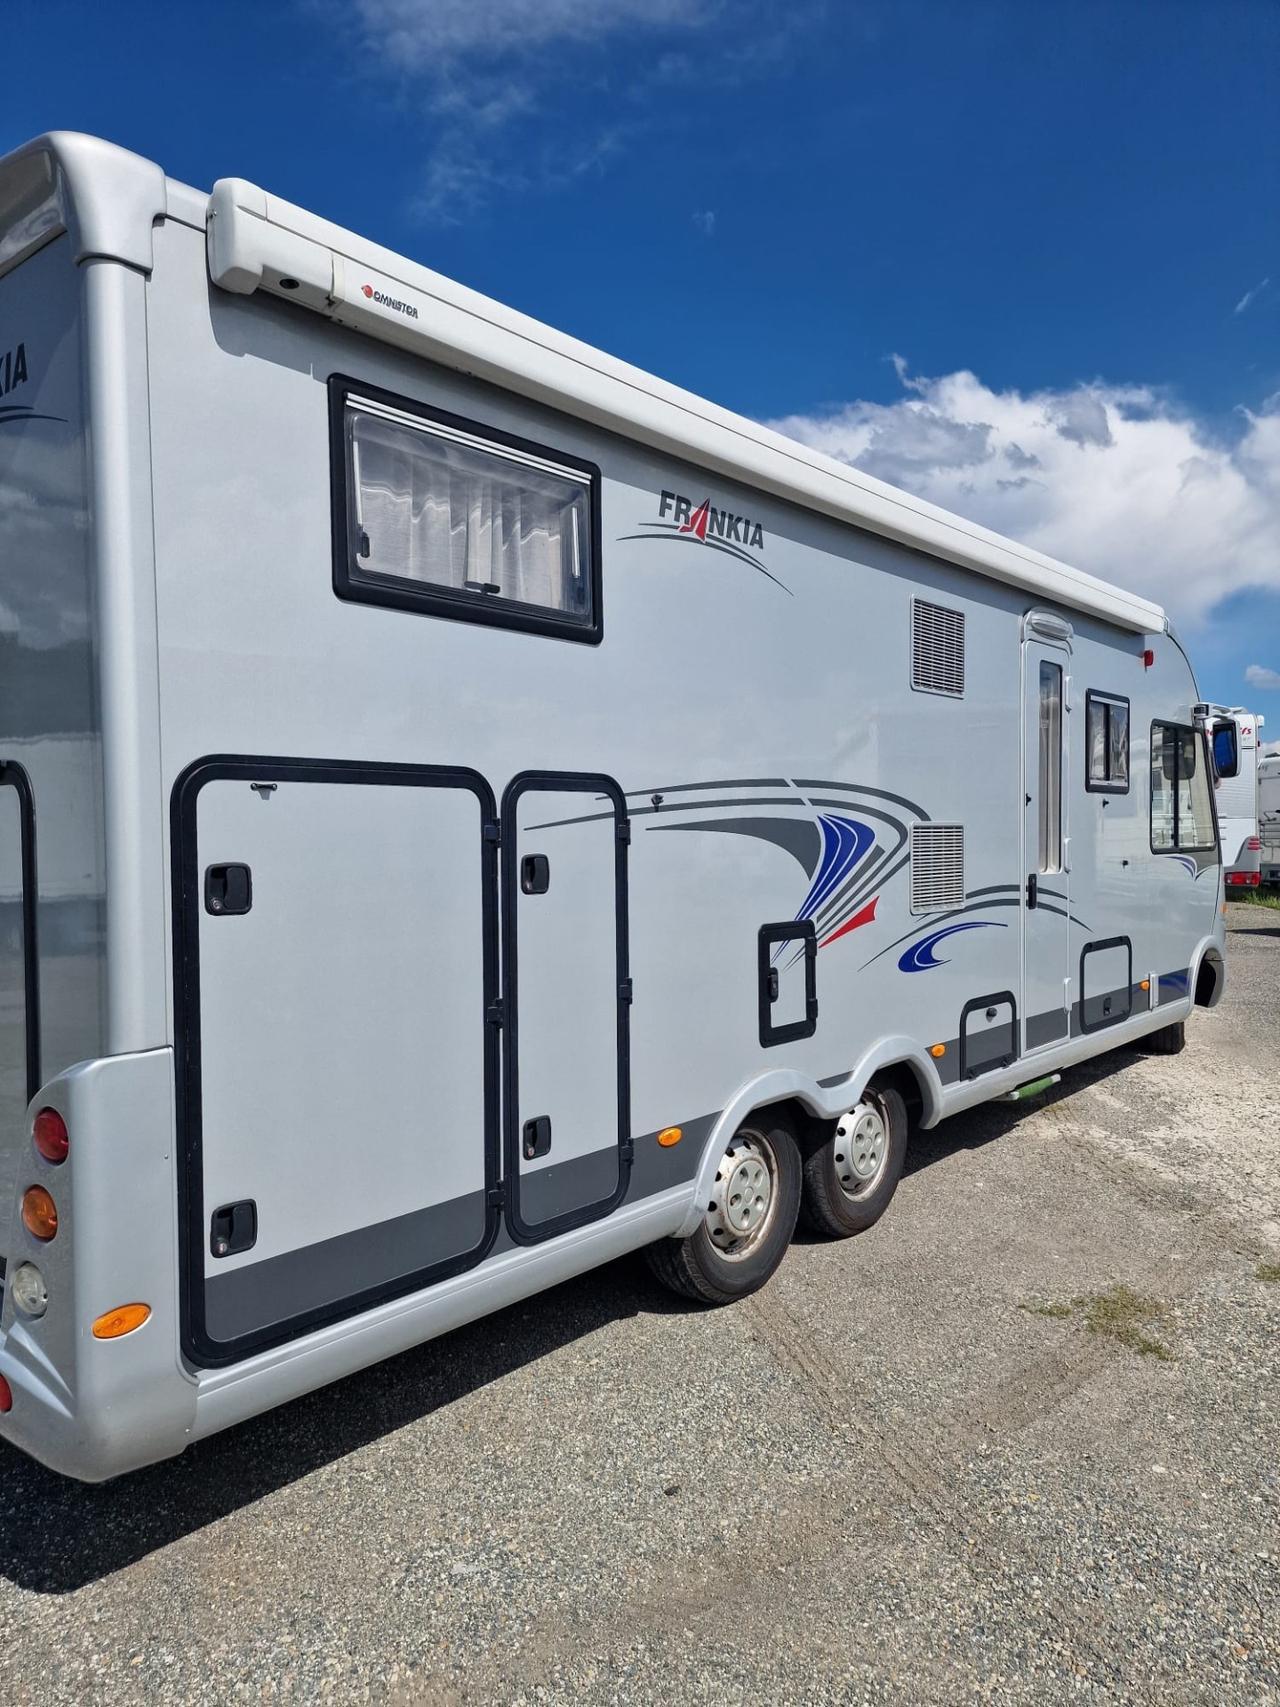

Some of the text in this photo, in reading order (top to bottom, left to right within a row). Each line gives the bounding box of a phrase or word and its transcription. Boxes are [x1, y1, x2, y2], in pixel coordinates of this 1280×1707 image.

[373, 290, 418, 319] OMNISTOR
[0, 342, 28, 398] IA
[659, 490, 764, 549] FRANKIA
